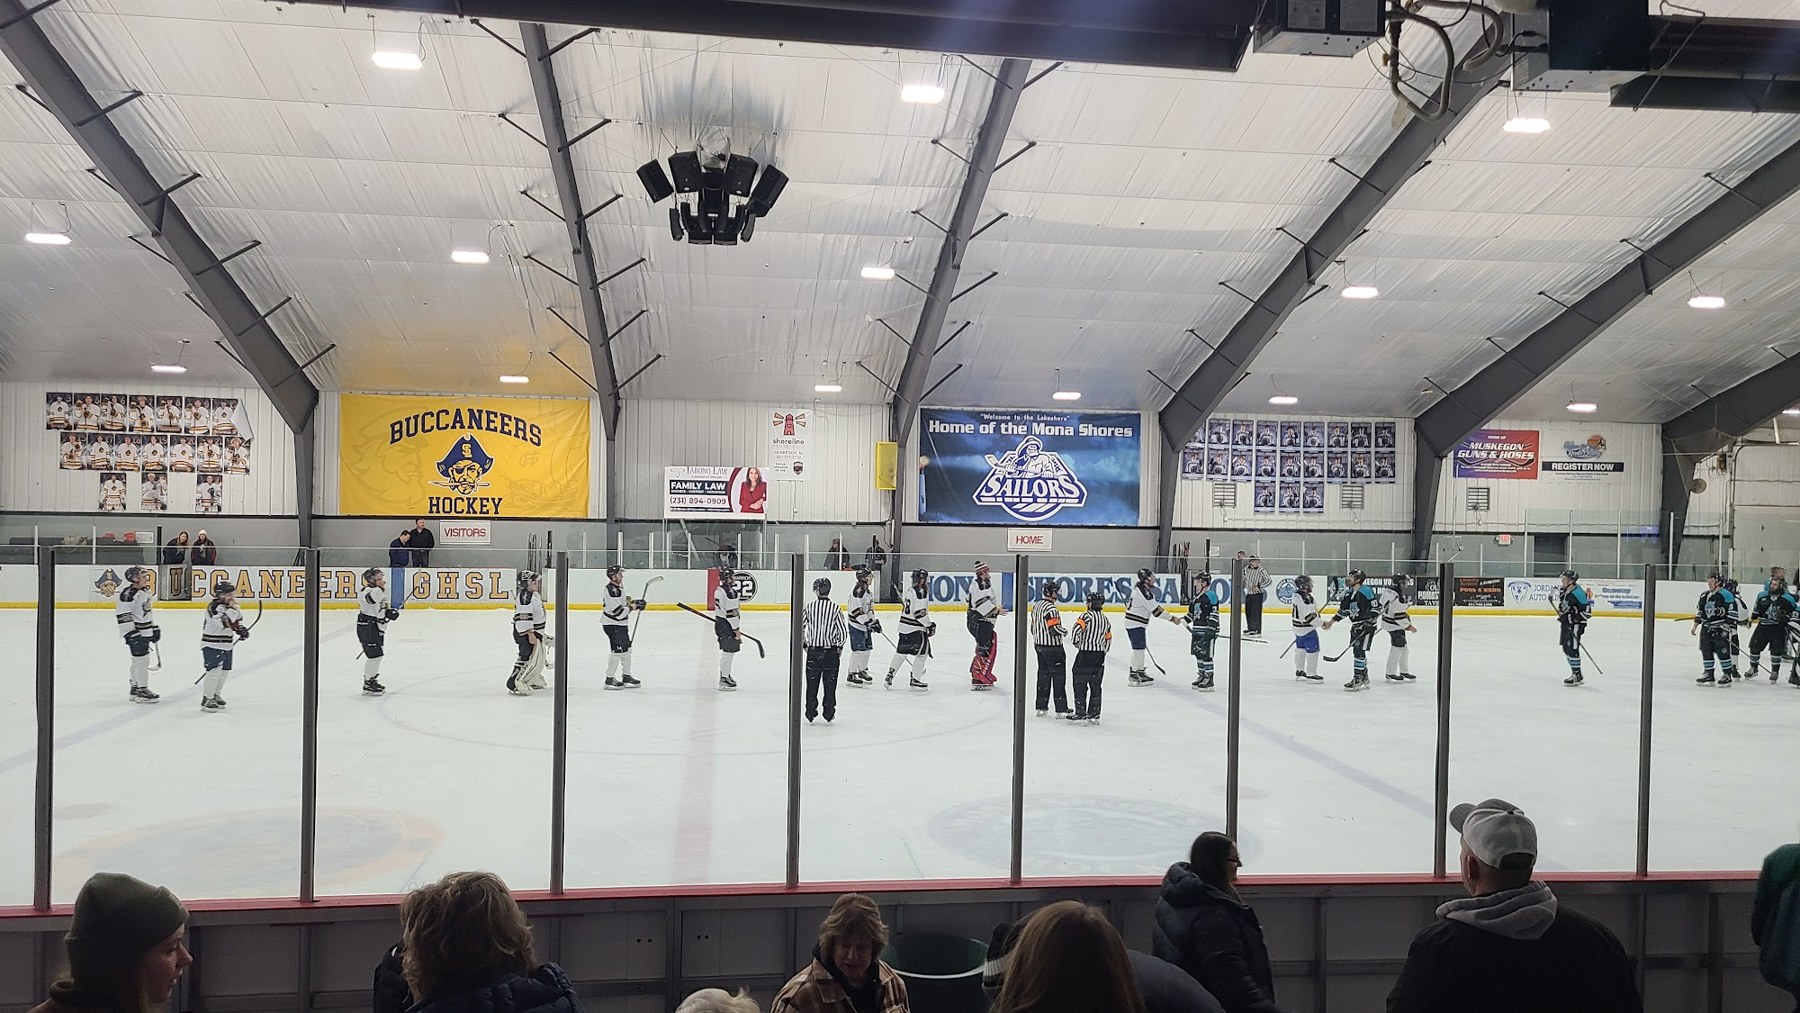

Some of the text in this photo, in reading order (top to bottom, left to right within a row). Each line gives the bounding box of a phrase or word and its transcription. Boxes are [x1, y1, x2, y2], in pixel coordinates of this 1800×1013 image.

[389, 408, 542, 447] BUCCANEERS
[929, 420, 1133, 437] Home of the Mona Shores
[1469, 442, 1524, 450] MUSKEGON
[1457, 449, 1535, 460] GUNS & HOSES
[1551, 463, 1615, 471] REGISTER NOW
[671, 481, 726, 490] FAMILY LAW
[981, 474, 1080, 498] SAILORS
[428, 496, 503, 515] HOCKEY
[670, 496, 727, 505] (231) 894-0909
[443, 527, 487, 538] VISITORS
[1015, 535, 1044, 544] HOME
[412, 572, 510, 601] GHSL
[1528, 593, 1547, 601] AUTO
